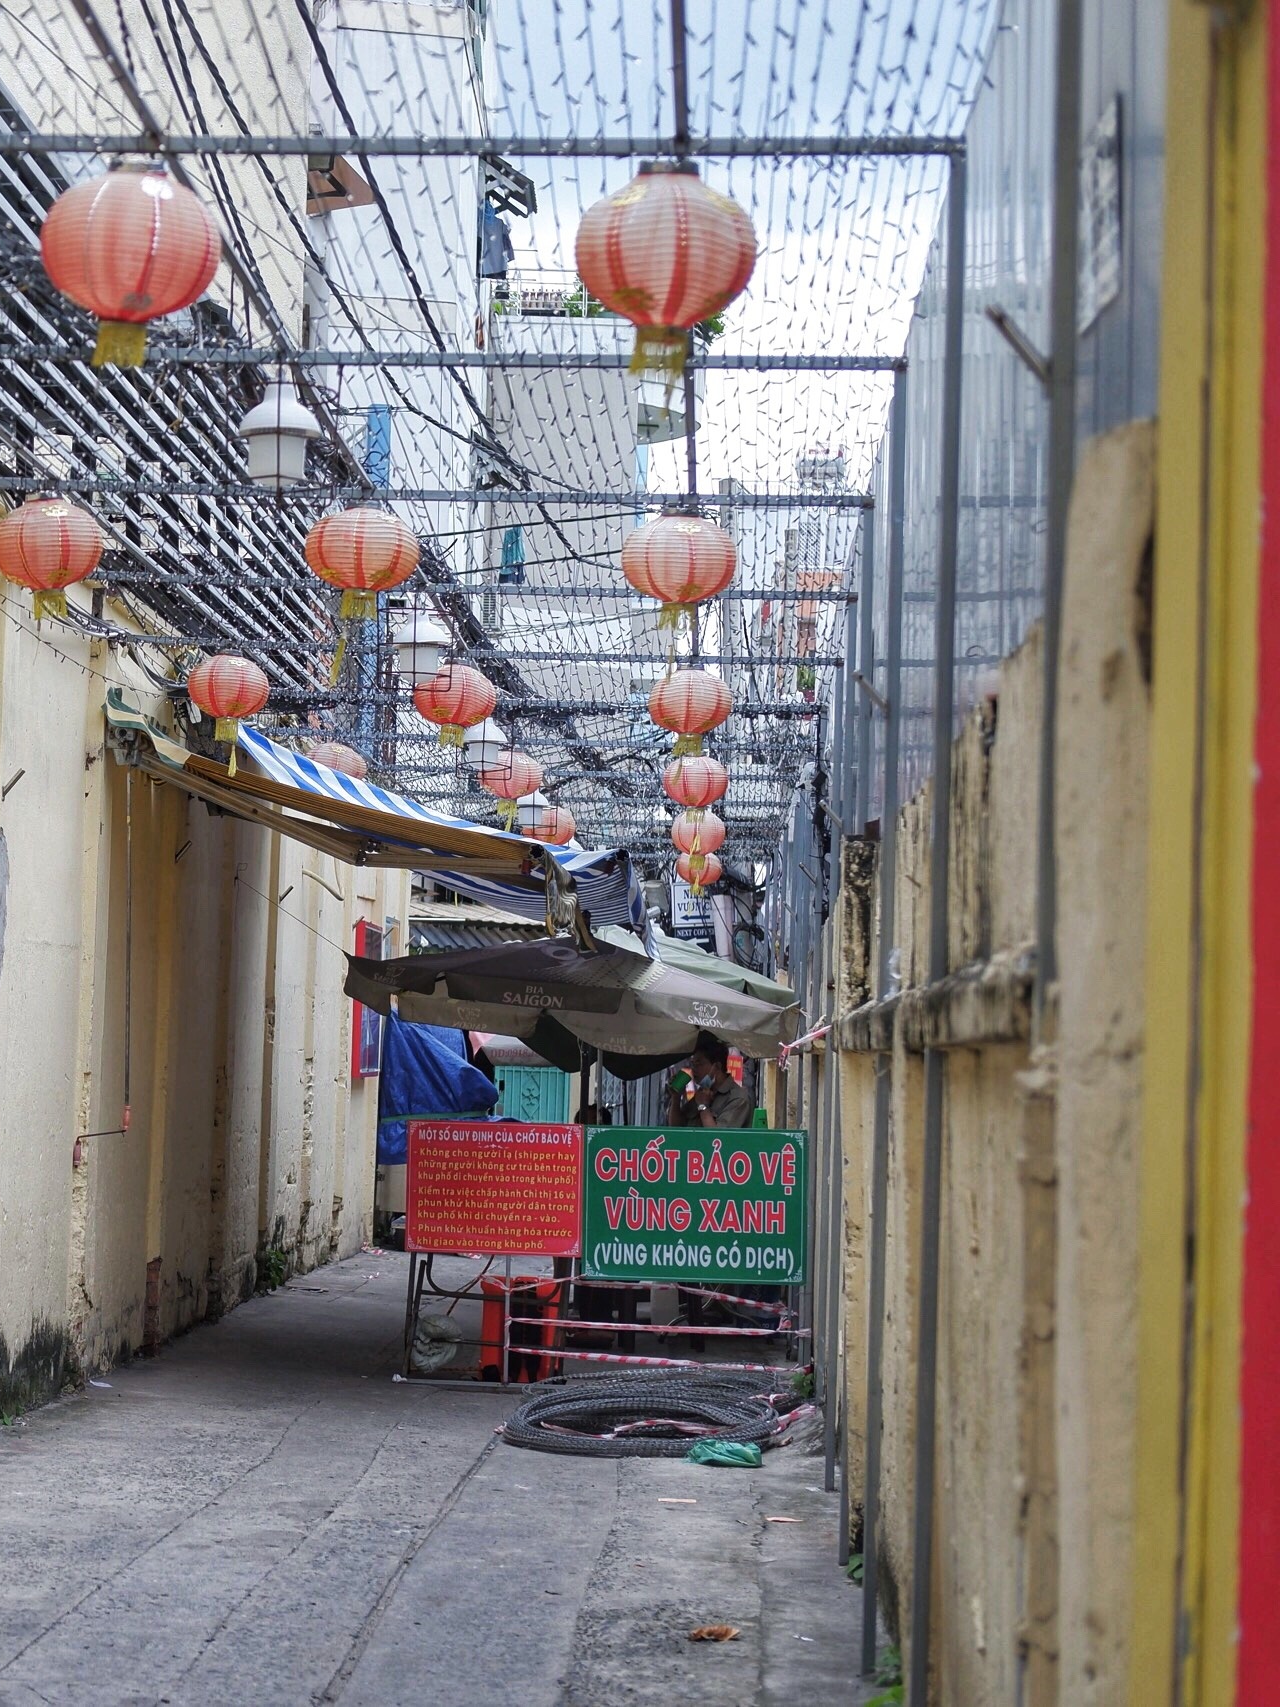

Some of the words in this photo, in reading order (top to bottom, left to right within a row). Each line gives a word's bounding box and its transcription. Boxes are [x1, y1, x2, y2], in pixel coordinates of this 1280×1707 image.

[676, 929, 692, 937] NEXT
[526, 986, 544, 994] BIA
[502, 992, 563, 1009] SAIGON
[688, 1016, 725, 1028] SAIGON
[419, 1127, 436, 1143] MỘT
[439, 1126, 450, 1141] SỐ
[452, 1130, 470, 1141] QUY
[472, 1131, 493, 1144] ĐỊNH
[495, 1128, 513, 1143] CỦA
[516, 1128, 539, 1144] CHỐT
[541, 1128, 560, 1144] BẢO
[561, 1128, 572, 1147] VỆ
[420, 1148, 450, 1158] Không
[452, 1149, 470, 1158] cho
[472, 1149, 501, 1160] người
[503, 1150, 512, 1160] lạ
[514, 1151, 556, 1162] (shipper
[558, 1152, 575, 1162] hay
[418, 1160, 447, 1170] những
[448, 1160, 475, 1170] người
[478, 1160, 504, 1171] không
[534, 1163, 551, 1172] bên
[553, 1165, 577, 1174] trong
[594, 1134, 681, 1183] CHỐT
[687, 1138, 752, 1185] BẢO
[759, 1143, 796, 1196] VỆ
[418, 1171, 434, 1180] khu
[512, 1176, 535, 1185] trong
[536, 1176, 553, 1184] khu
[442, 1188, 455, 1196] tra
[554, 1191, 564, 1199] 16
[418, 1199, 442, 1209] phun
[497, 1201, 526, 1211] người
[528, 1202, 546, 1210] dân
[548, 1204, 574, 1213] trong
[604, 1186, 692, 1232] VÙNG
[698, 1199, 786, 1234] XANH
[418, 1210, 435, 1219] khu
[458, 1212, 472, 1220] khi
[418, 1224, 443, 1233] Phun
[498, 1226, 521, 1237] hàng
[417, 1236, 432, 1245] khi
[434, 1237, 454, 1247] giao
[476, 1239, 502, 1249] trong
[504, 1239, 522, 1248] khu
[594, 1236, 647, 1271] (VÙNG
[652, 1238, 712, 1268] KHÔNG
[716, 1240, 742, 1268] CÓ
[746, 1247, 795, 1276] DỊCH)
